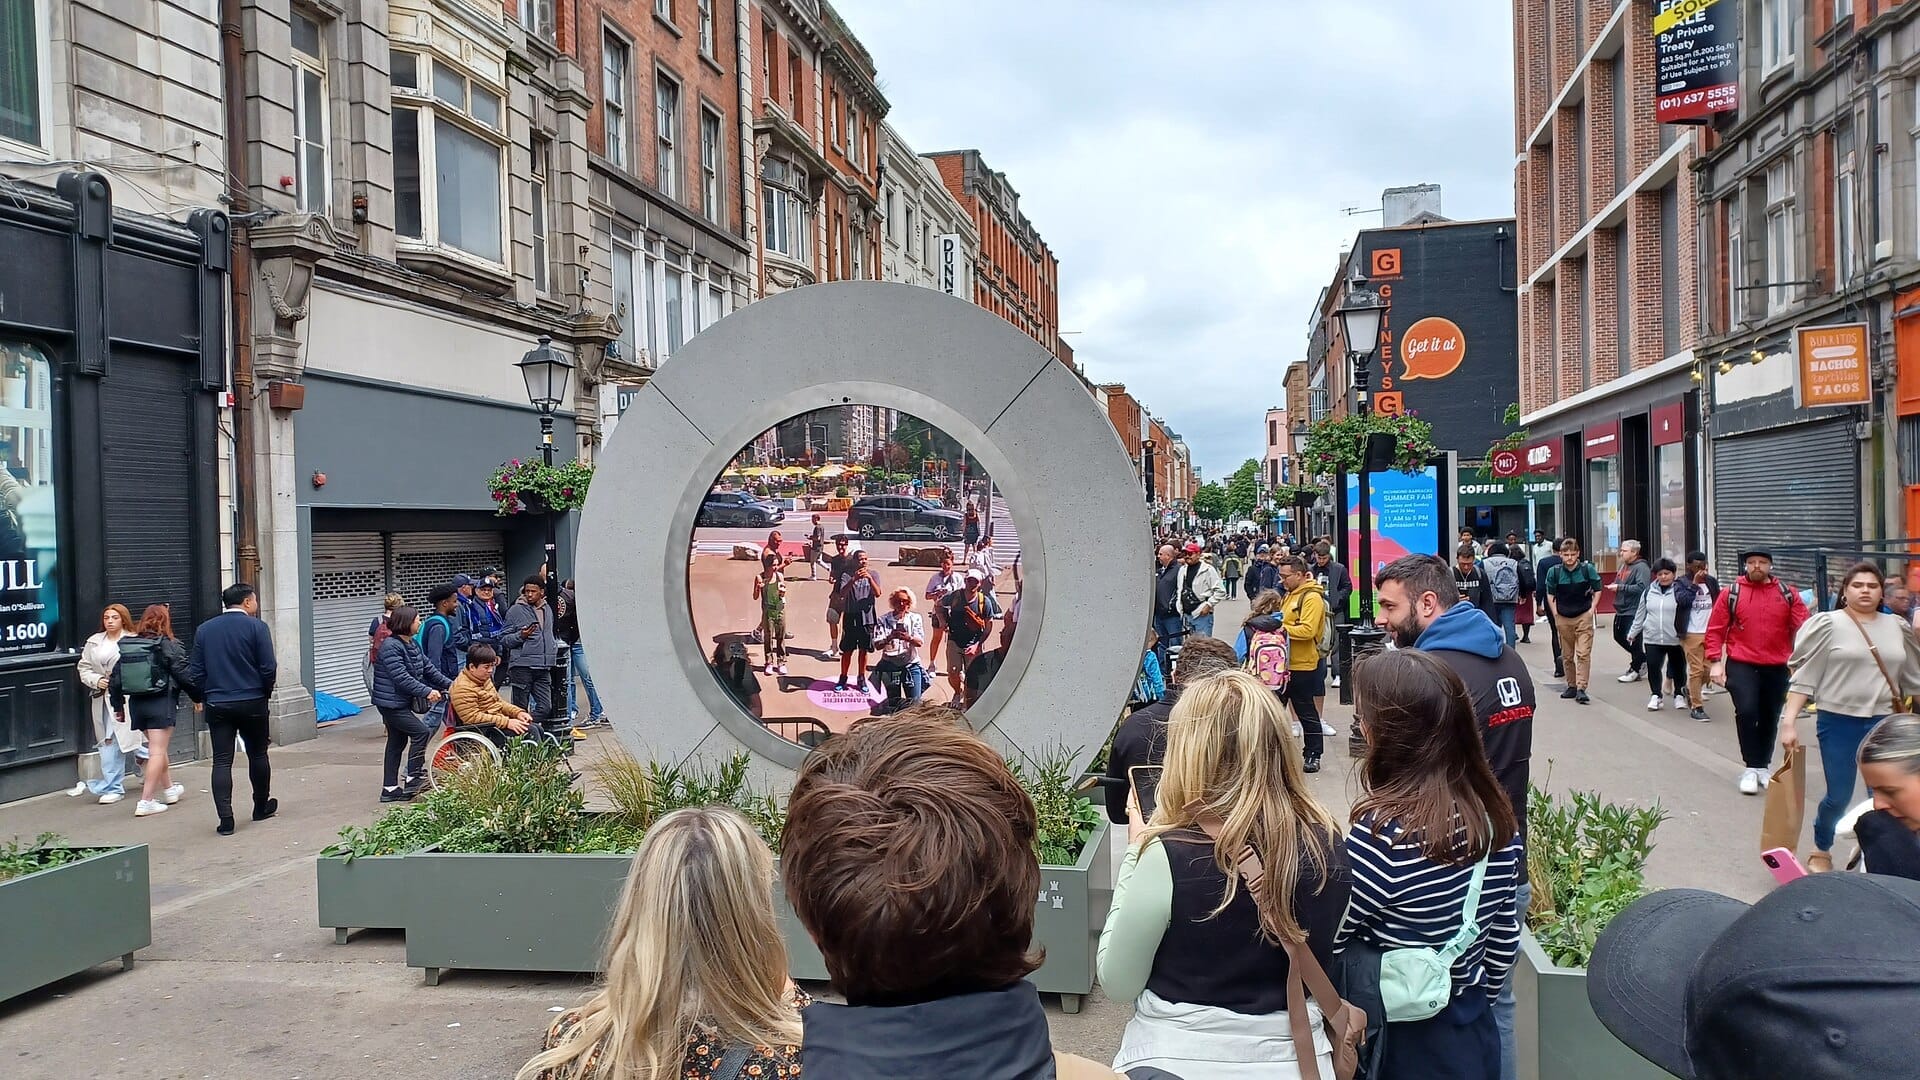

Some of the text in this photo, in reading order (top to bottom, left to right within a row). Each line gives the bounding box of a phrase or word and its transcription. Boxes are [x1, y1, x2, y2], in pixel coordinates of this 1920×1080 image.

[1674, 0, 1710, 19] SOL
[1661, 24, 1714, 44] By Private
[1661, 40, 1694, 54] Treaty
[1661, 61, 1687, 72] Suitable
[1689, 58, 1699, 66] for
[1706, 52, 1730, 62] Variety
[1683, 65, 1709, 75] Subject
[1660, 86, 1736, 110] (01) 637 5555
[1408, 336, 1456, 359] Get it at
[1810, 333, 1857, 348] BURRITOS
[1810, 358, 1858, 372] NACHOS
[1812, 382, 1860, 395] TACOS
[1459, 484, 1504, 495] COFFEE
[6, 622, 48, 641] 1600
